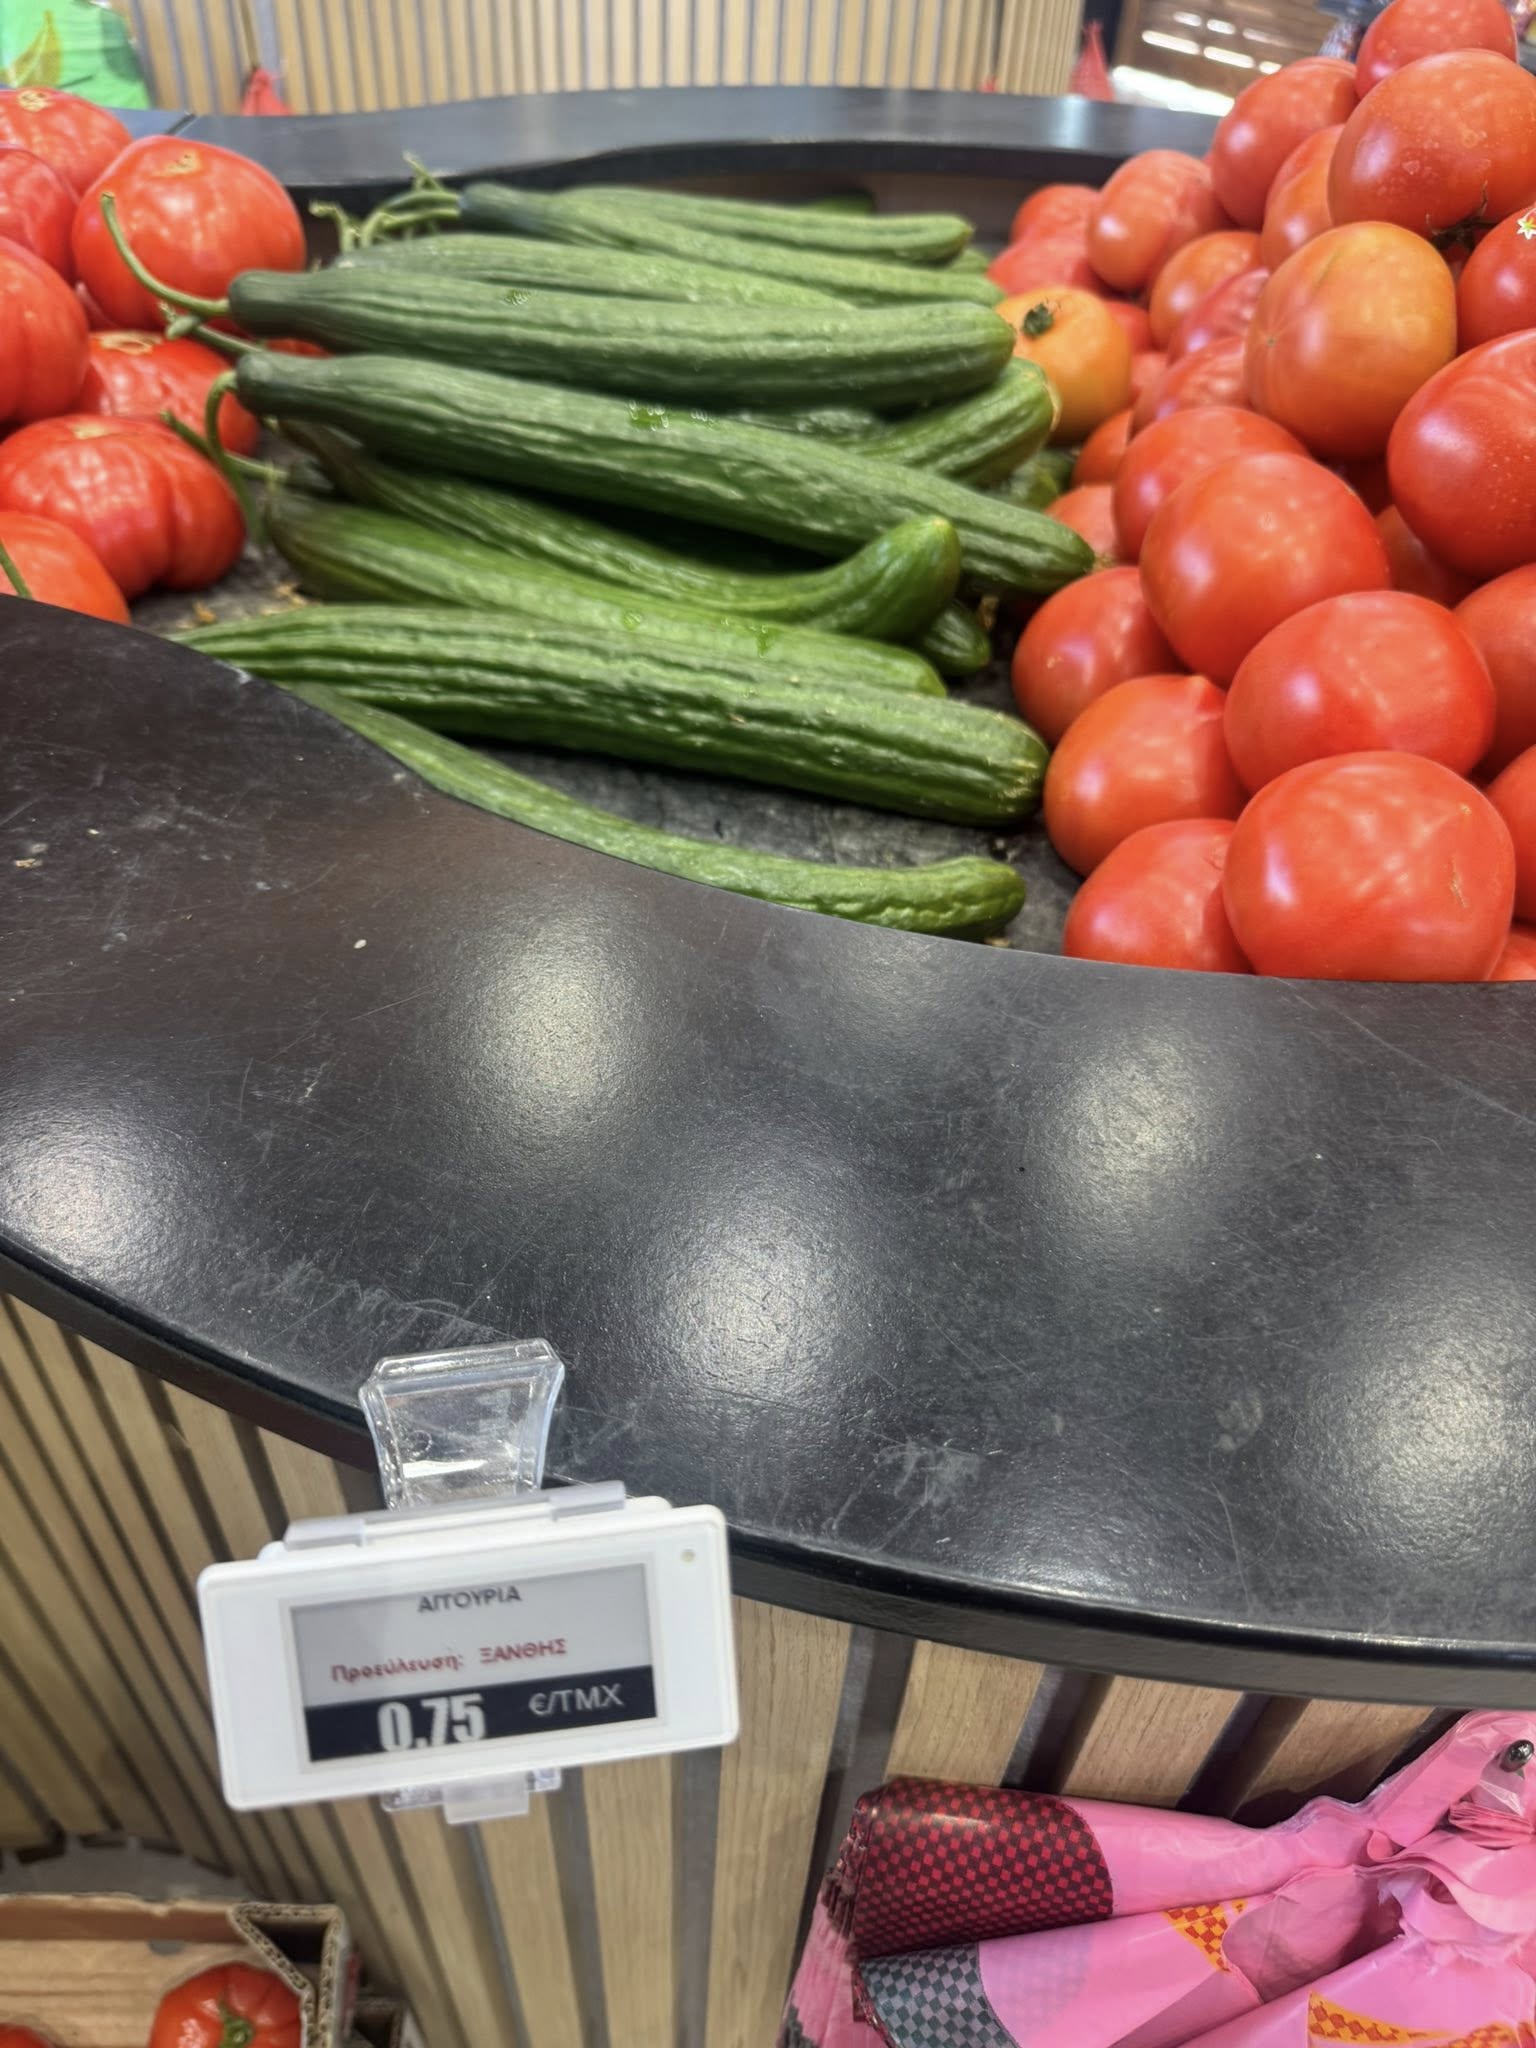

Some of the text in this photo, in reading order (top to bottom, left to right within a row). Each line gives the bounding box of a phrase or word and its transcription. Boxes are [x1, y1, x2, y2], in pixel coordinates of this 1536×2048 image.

[479, 1638, 566, 1663] ΞΑΝΘΗΣ
[378, 1683, 624, 1752] 0.75 €/ΤΜΧ
